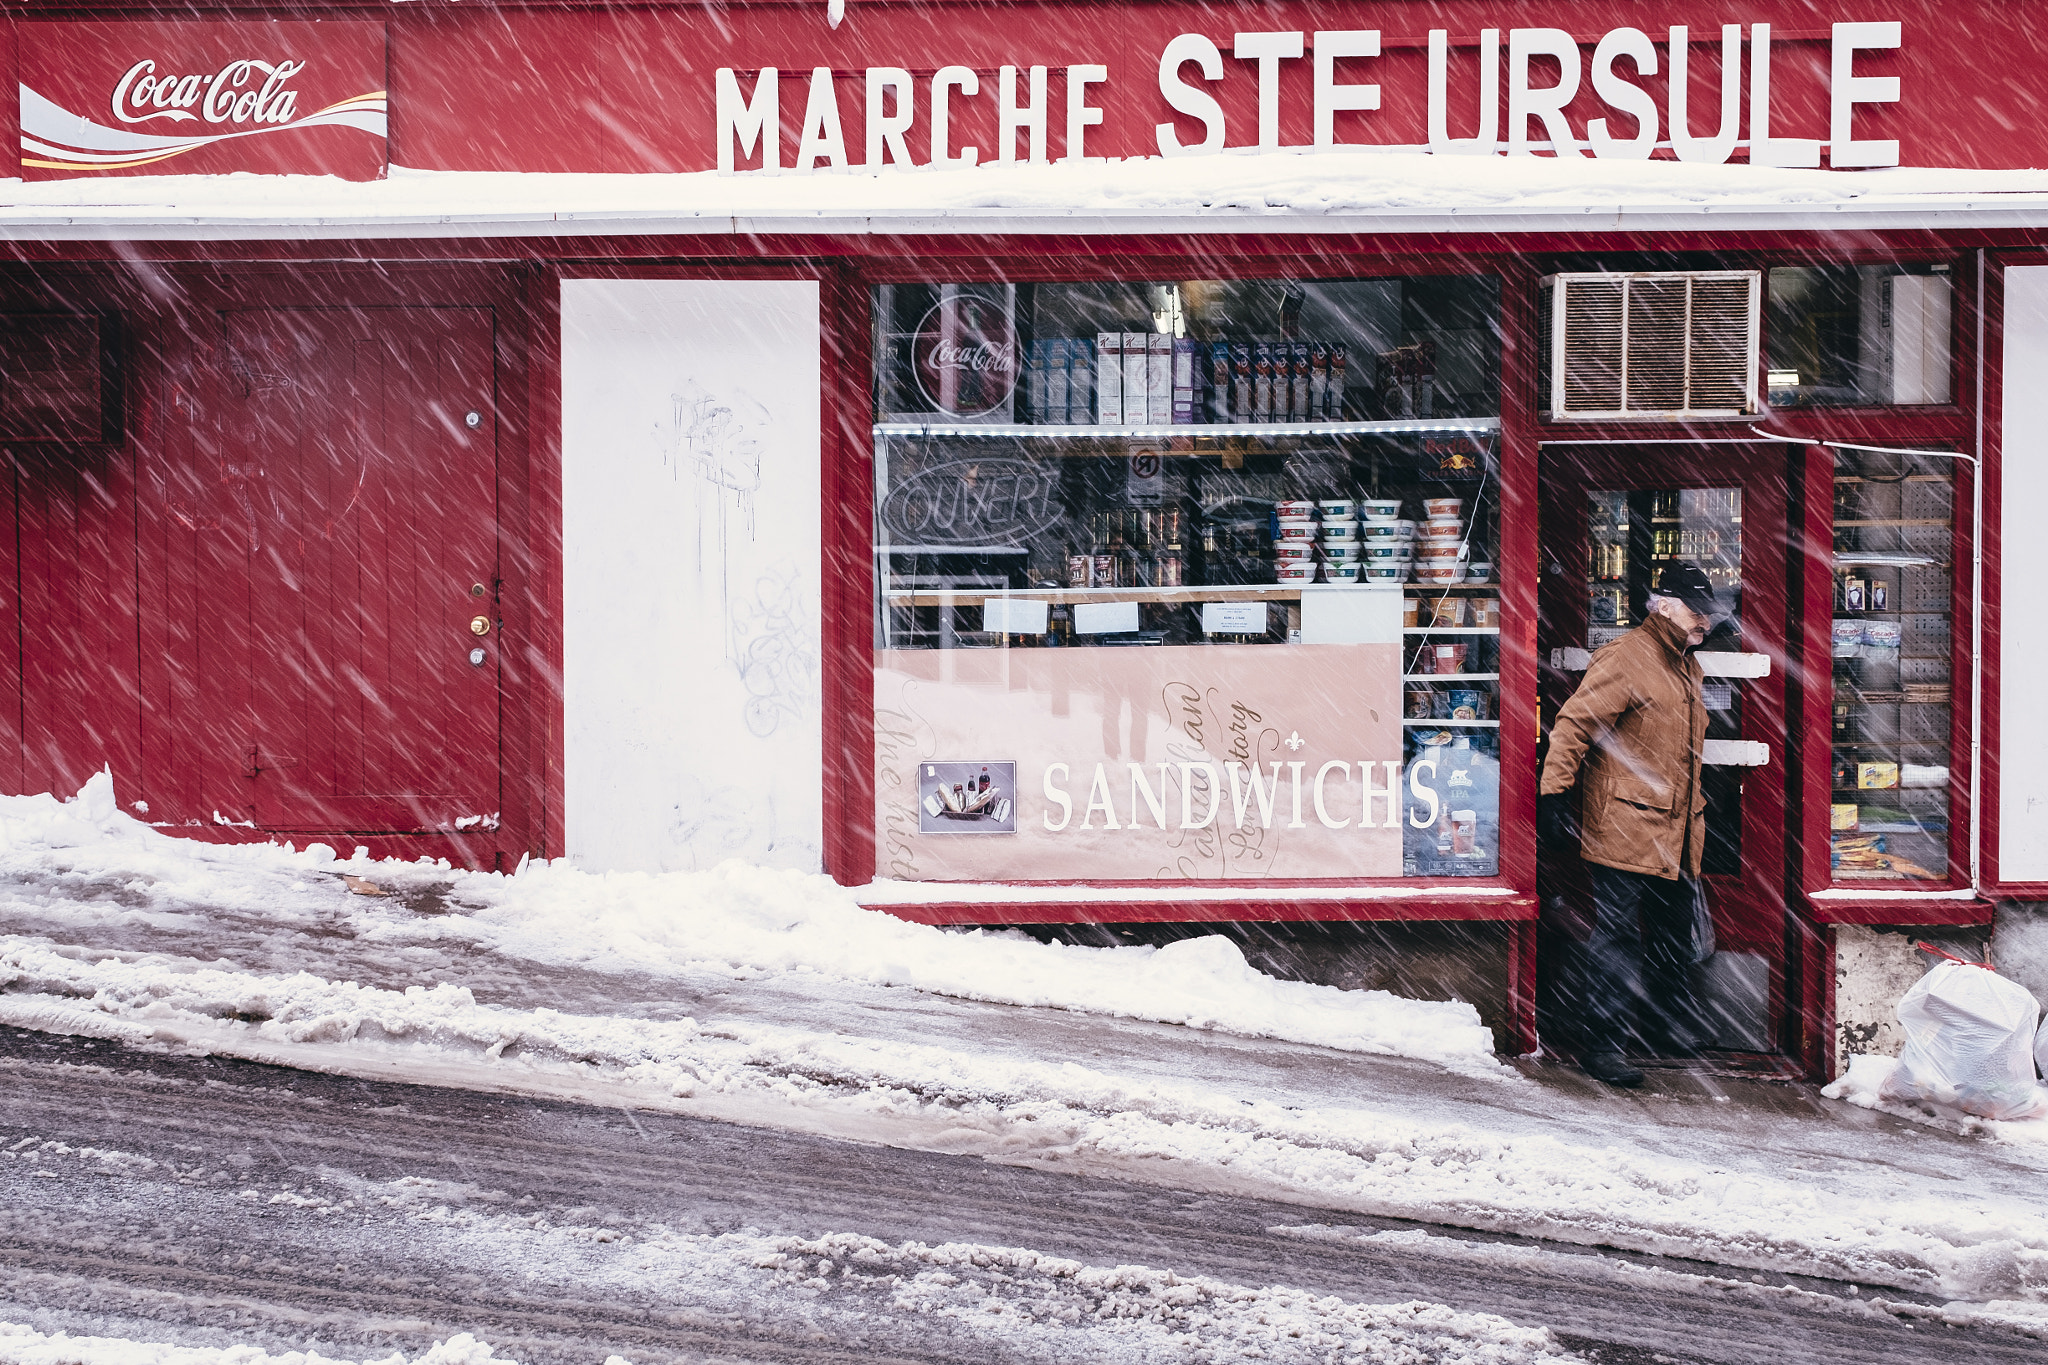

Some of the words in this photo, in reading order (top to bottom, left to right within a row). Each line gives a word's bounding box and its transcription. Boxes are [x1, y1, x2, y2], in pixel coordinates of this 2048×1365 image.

[112, 58, 305, 124] Coca-Cola
[715, 65, 1107, 177] MARCHE
[1155, 30, 1380, 157] STE
[1427, 21, 1901, 168] URSULE
[928, 338, 1013, 373] Coca-Cola
[901, 469, 1063, 532] OUVERT
[1042, 759, 1440, 832] SANDWICHS
[1450, 789, 1470, 799] IPA
